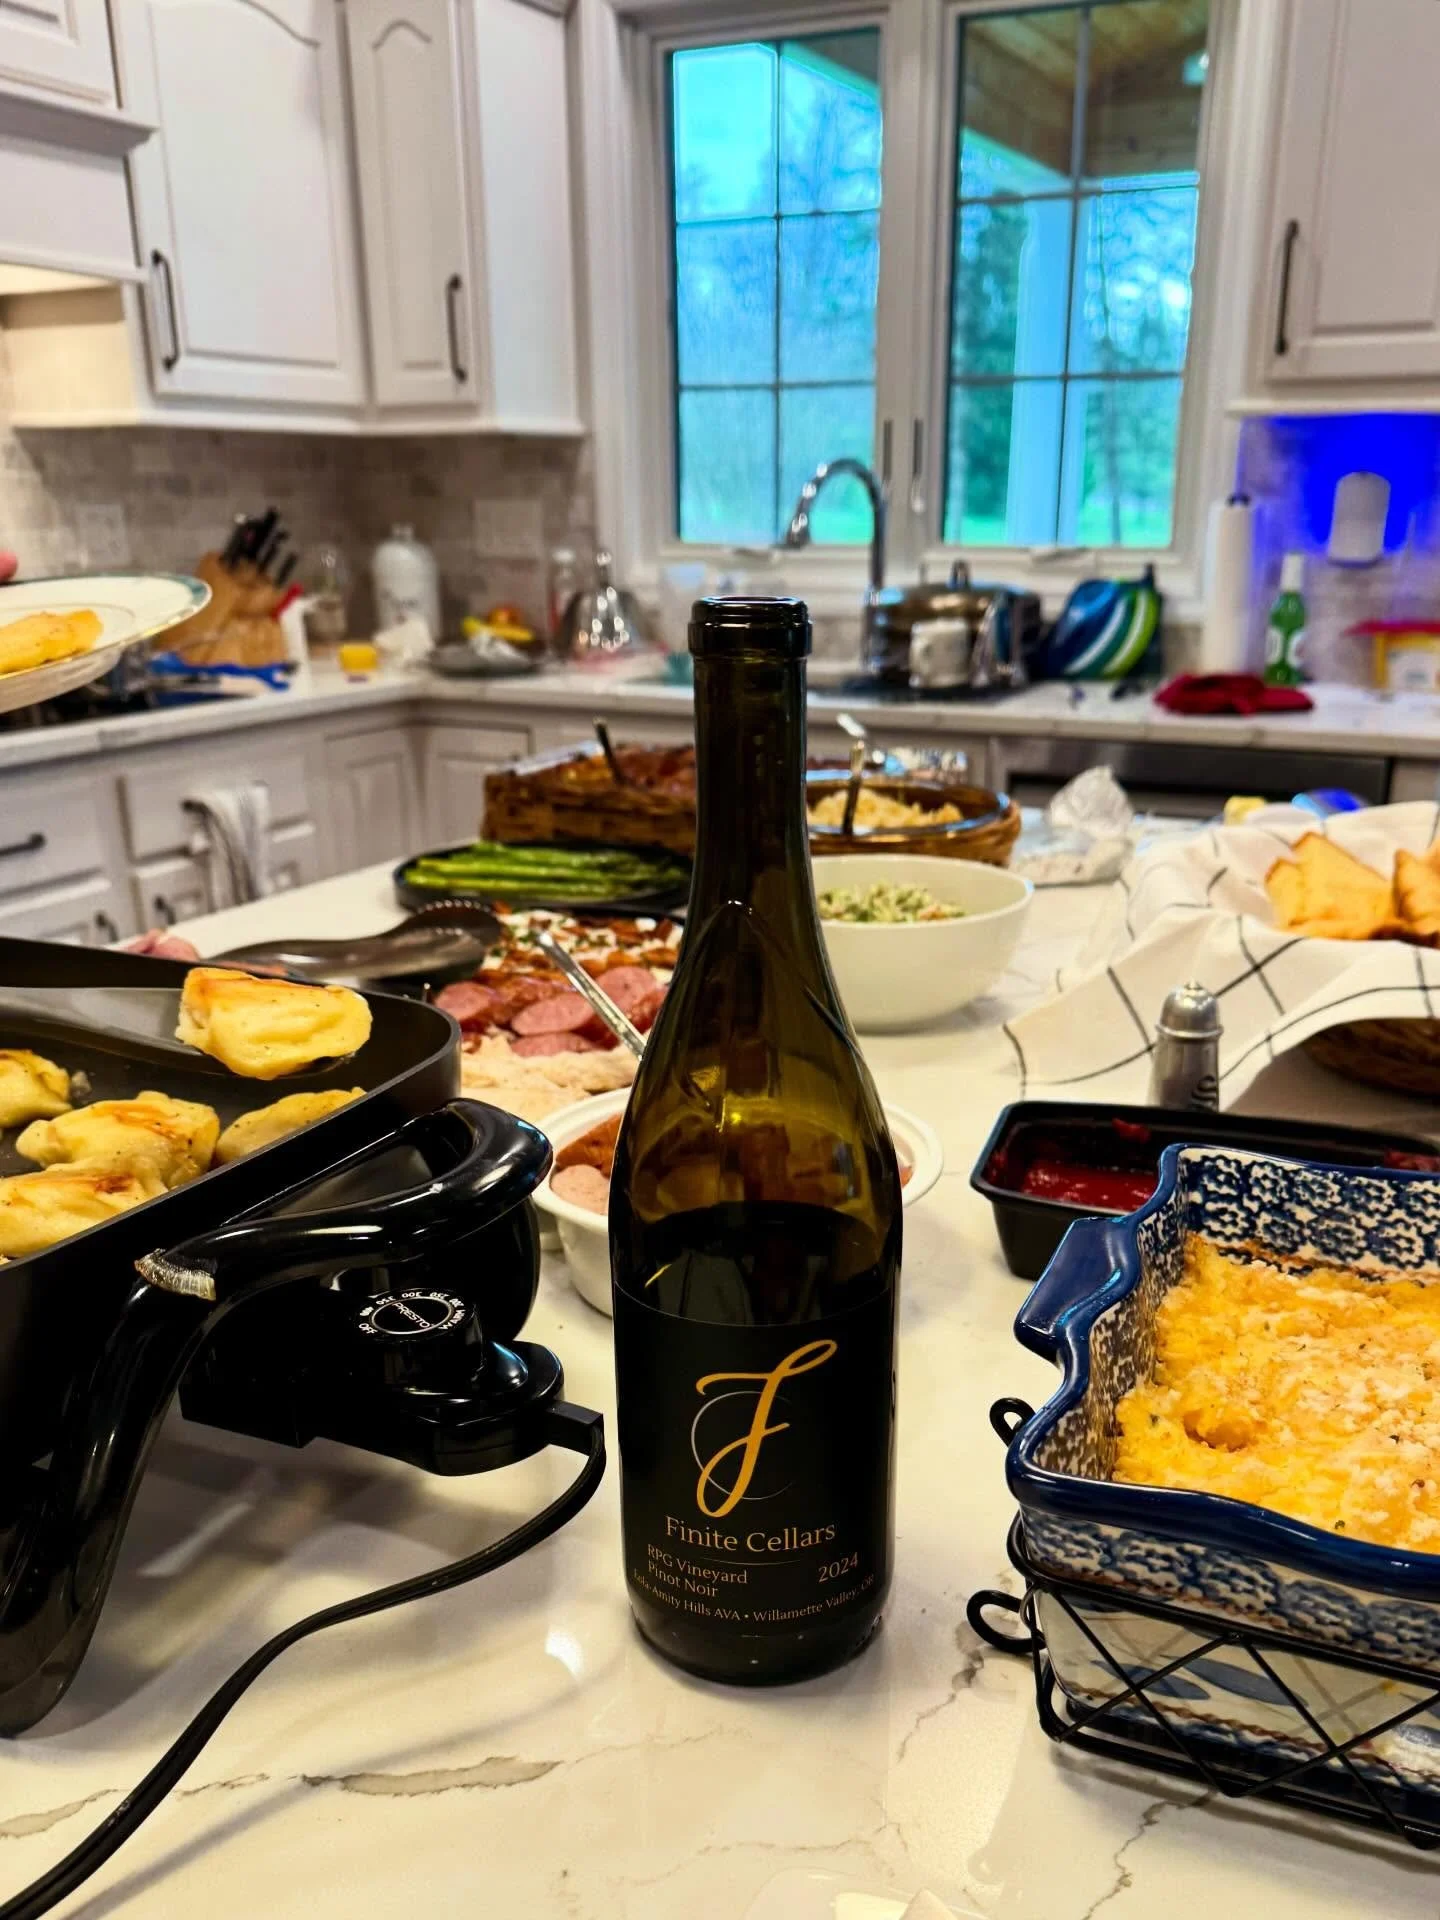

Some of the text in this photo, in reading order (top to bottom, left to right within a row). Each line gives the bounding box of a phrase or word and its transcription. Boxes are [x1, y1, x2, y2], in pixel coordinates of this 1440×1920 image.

[358, 1323, 379, 1335] OFF
[392, 1302, 431, 1329] PRESTO
[665, 1515, 836, 1552] Finite Cellars
[647, 1543, 748, 1584] RPG Vineyard
[647, 1560, 718, 1597] Pinot Noir
[818, 1552, 858, 1583] 2024
[684, 1600, 711, 1617] Hills
[714, 1607, 741, 1621] AVA
[753, 1603, 823, 1622] Willamette
